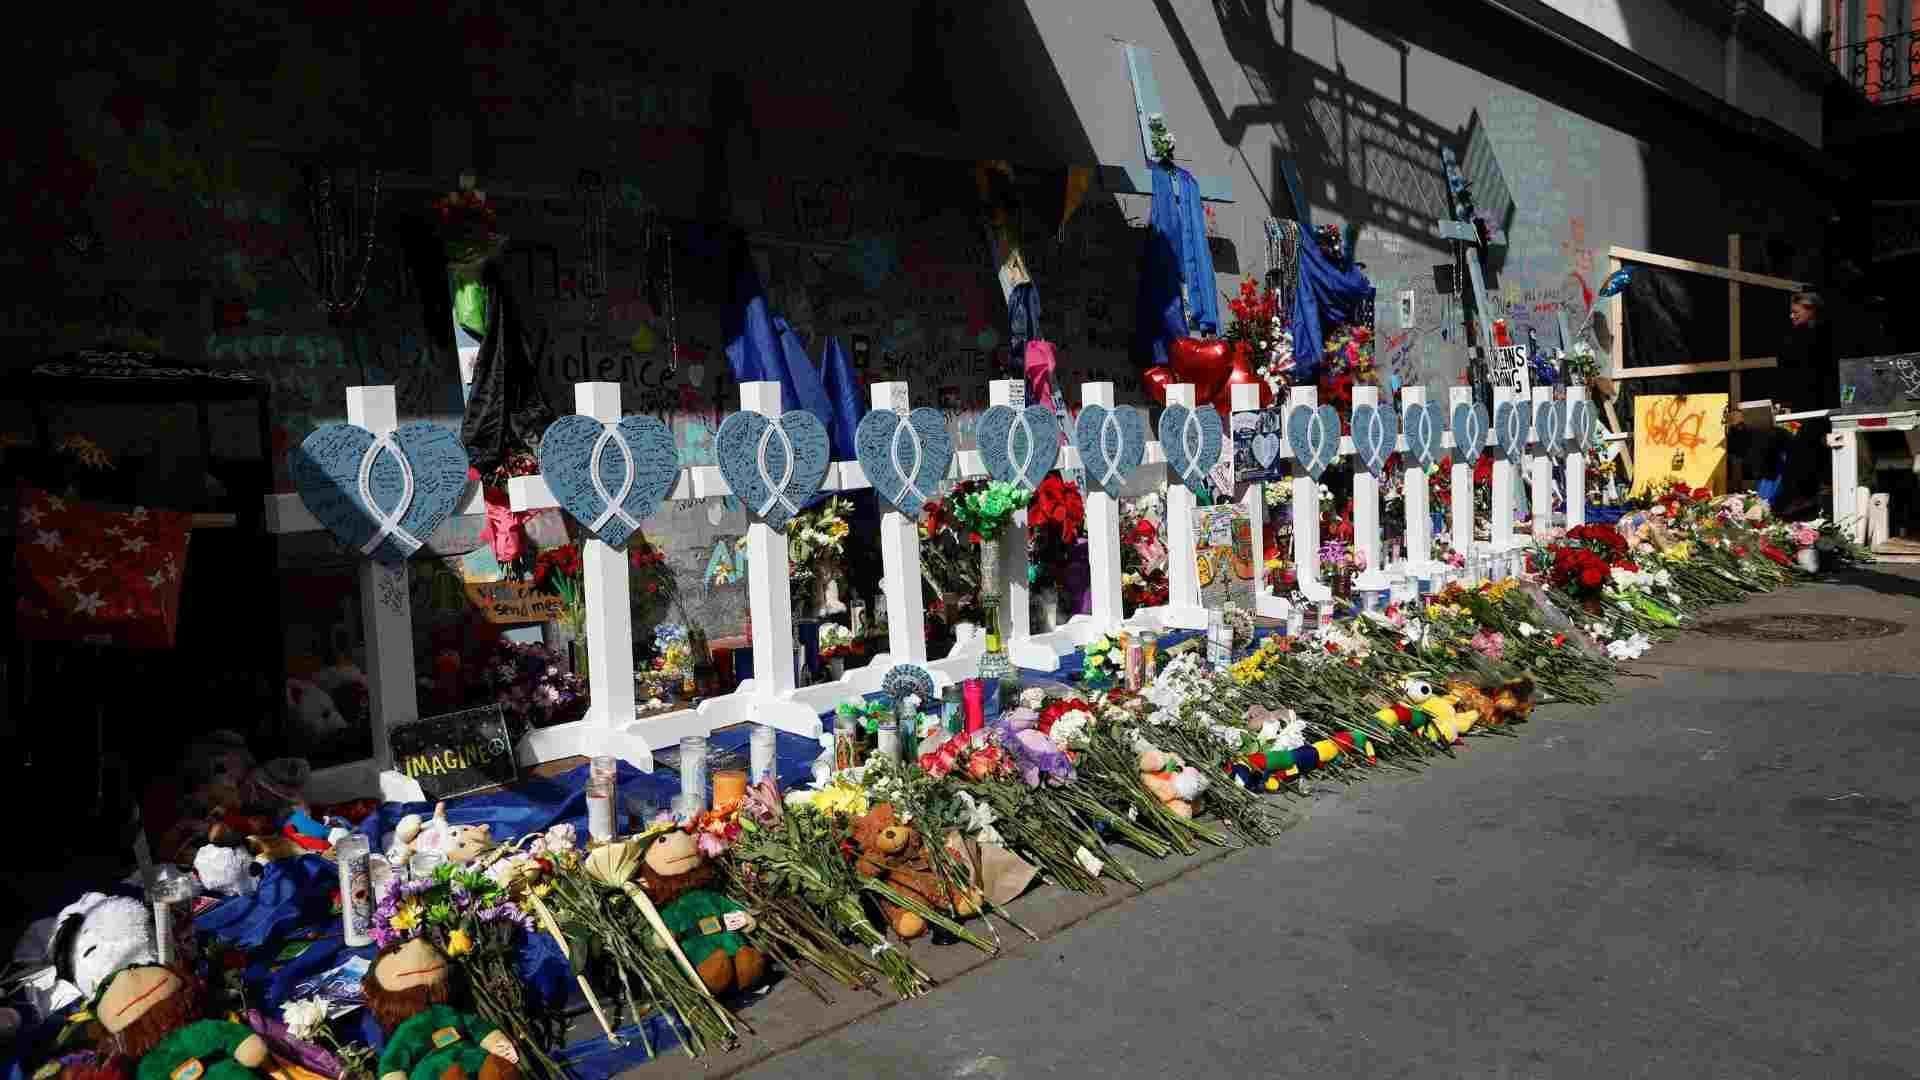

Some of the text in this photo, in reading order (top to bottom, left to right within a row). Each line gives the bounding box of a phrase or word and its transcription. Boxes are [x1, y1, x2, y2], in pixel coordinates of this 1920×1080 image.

[520, 327, 675, 388] Violence
[495, 601, 528, 617] send
[404, 741, 491, 782] IMAGINE
